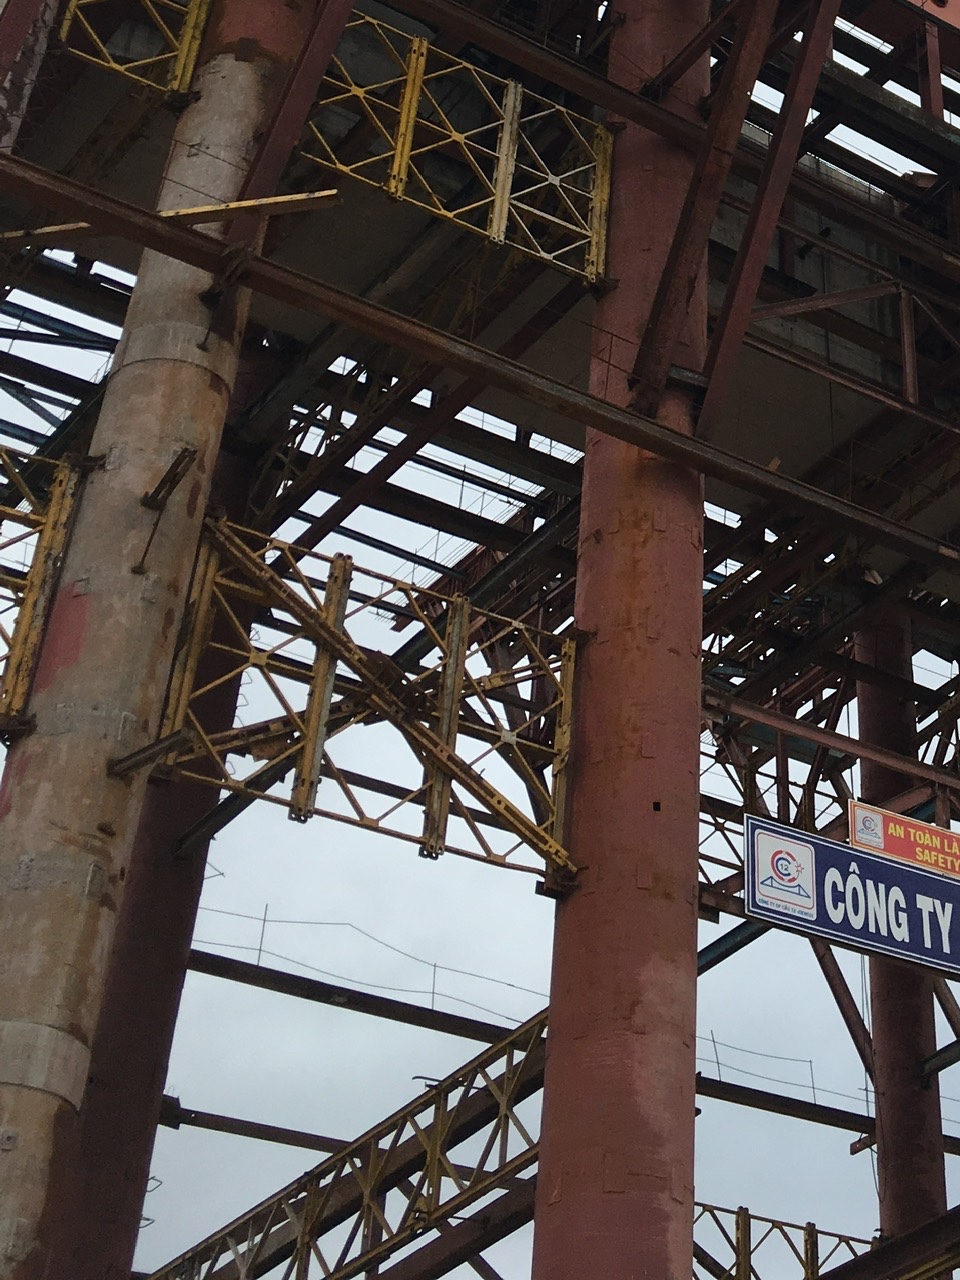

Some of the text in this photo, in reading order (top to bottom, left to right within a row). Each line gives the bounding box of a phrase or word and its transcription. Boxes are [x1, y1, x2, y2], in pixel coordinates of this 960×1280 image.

[888, 823, 904, 838] AN
[908, 828, 940, 849] TOÀN
[944, 838, 960, 855] LÀ
[915, 847, 960, 871] SAFETY
[824, 862, 910, 943] CÔNG
[916, 894, 953, 954] TY
